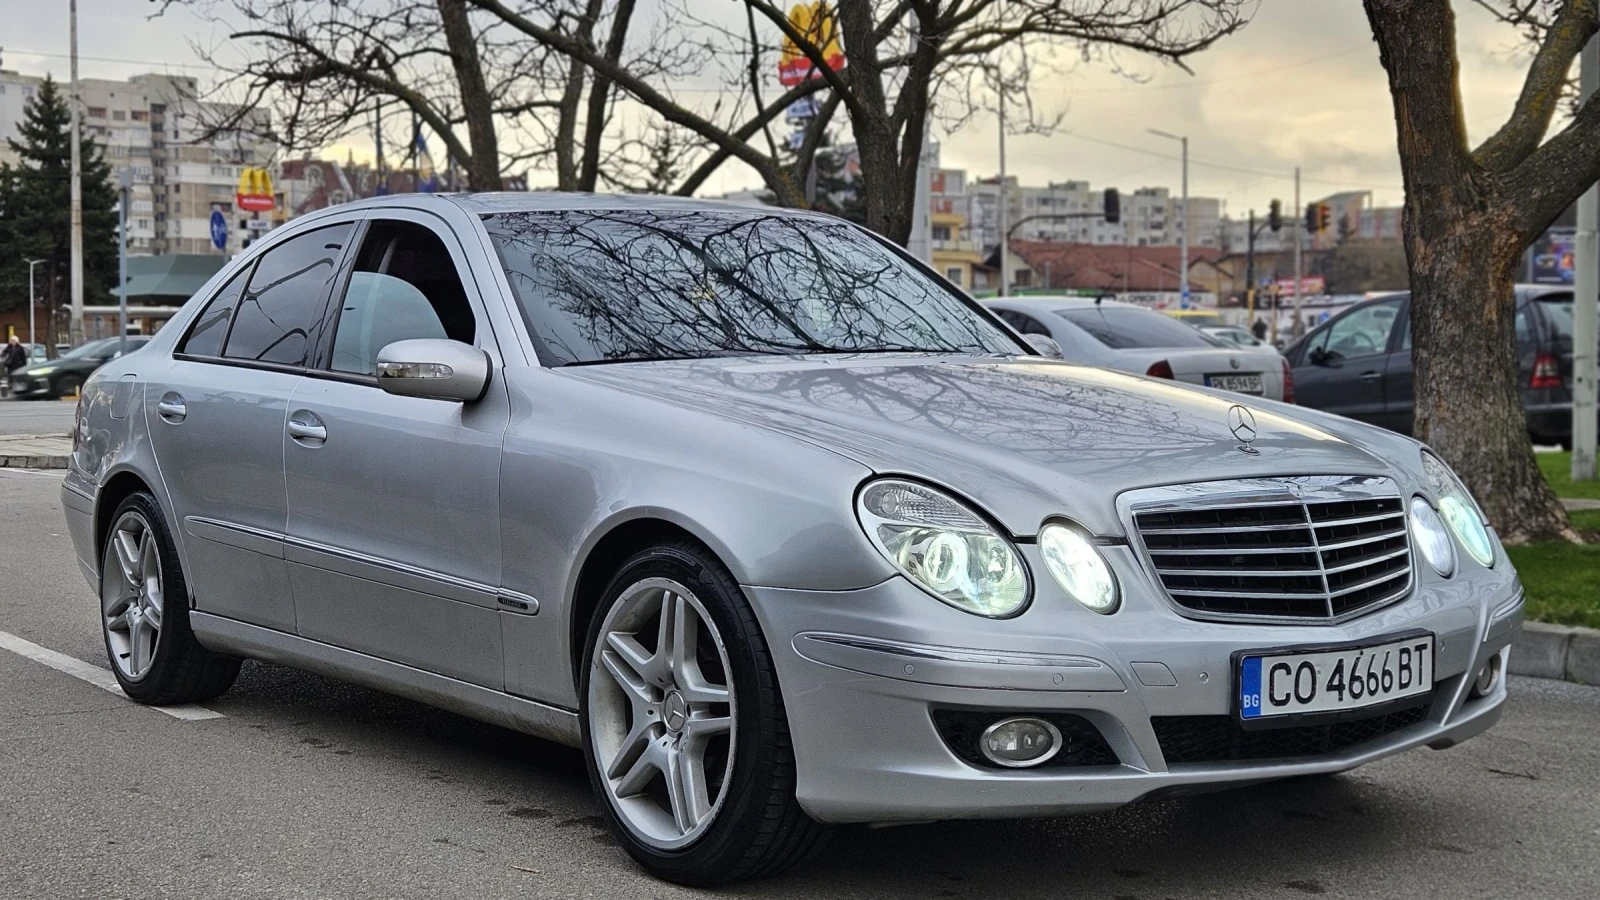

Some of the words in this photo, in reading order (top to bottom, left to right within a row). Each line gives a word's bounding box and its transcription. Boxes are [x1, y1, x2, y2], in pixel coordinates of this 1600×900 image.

[1269, 661, 1317, 707] CO
[1326, 650, 1394, 702] 4666
[1243, 694, 1260, 708] BG
